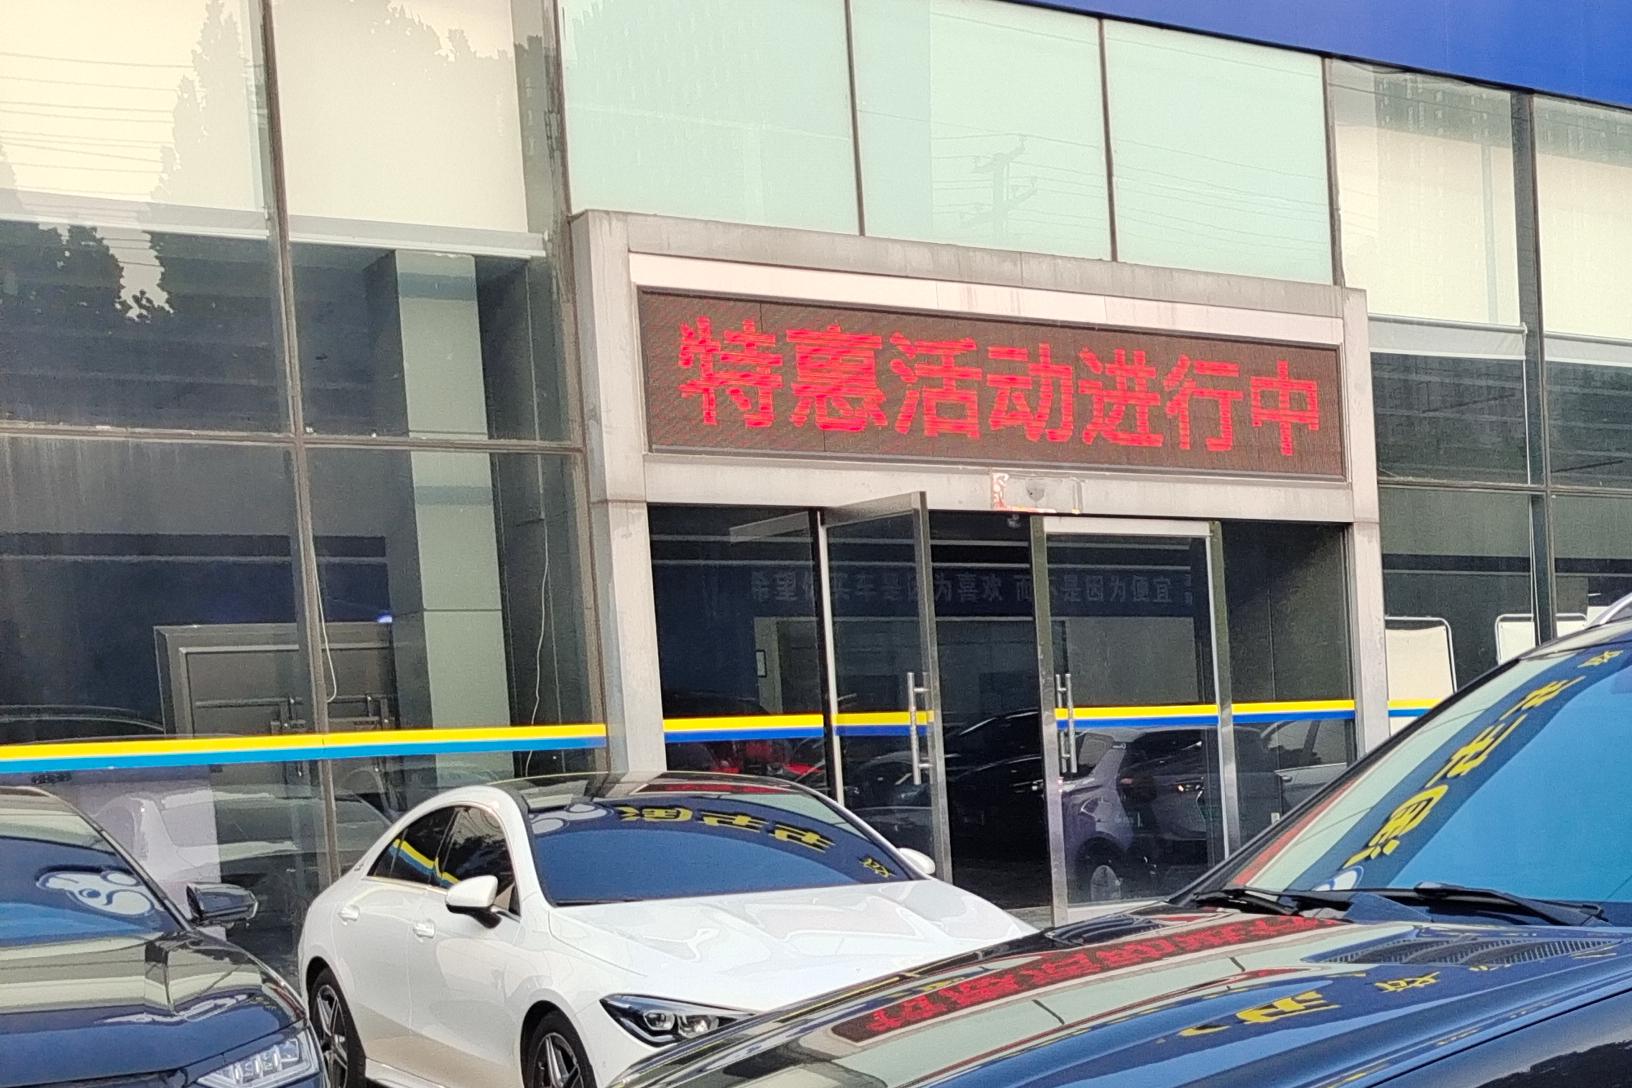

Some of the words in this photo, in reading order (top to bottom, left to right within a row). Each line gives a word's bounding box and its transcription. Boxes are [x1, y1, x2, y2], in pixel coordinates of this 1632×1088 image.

[678, 315, 1321, 457] 特惠活动进行中
